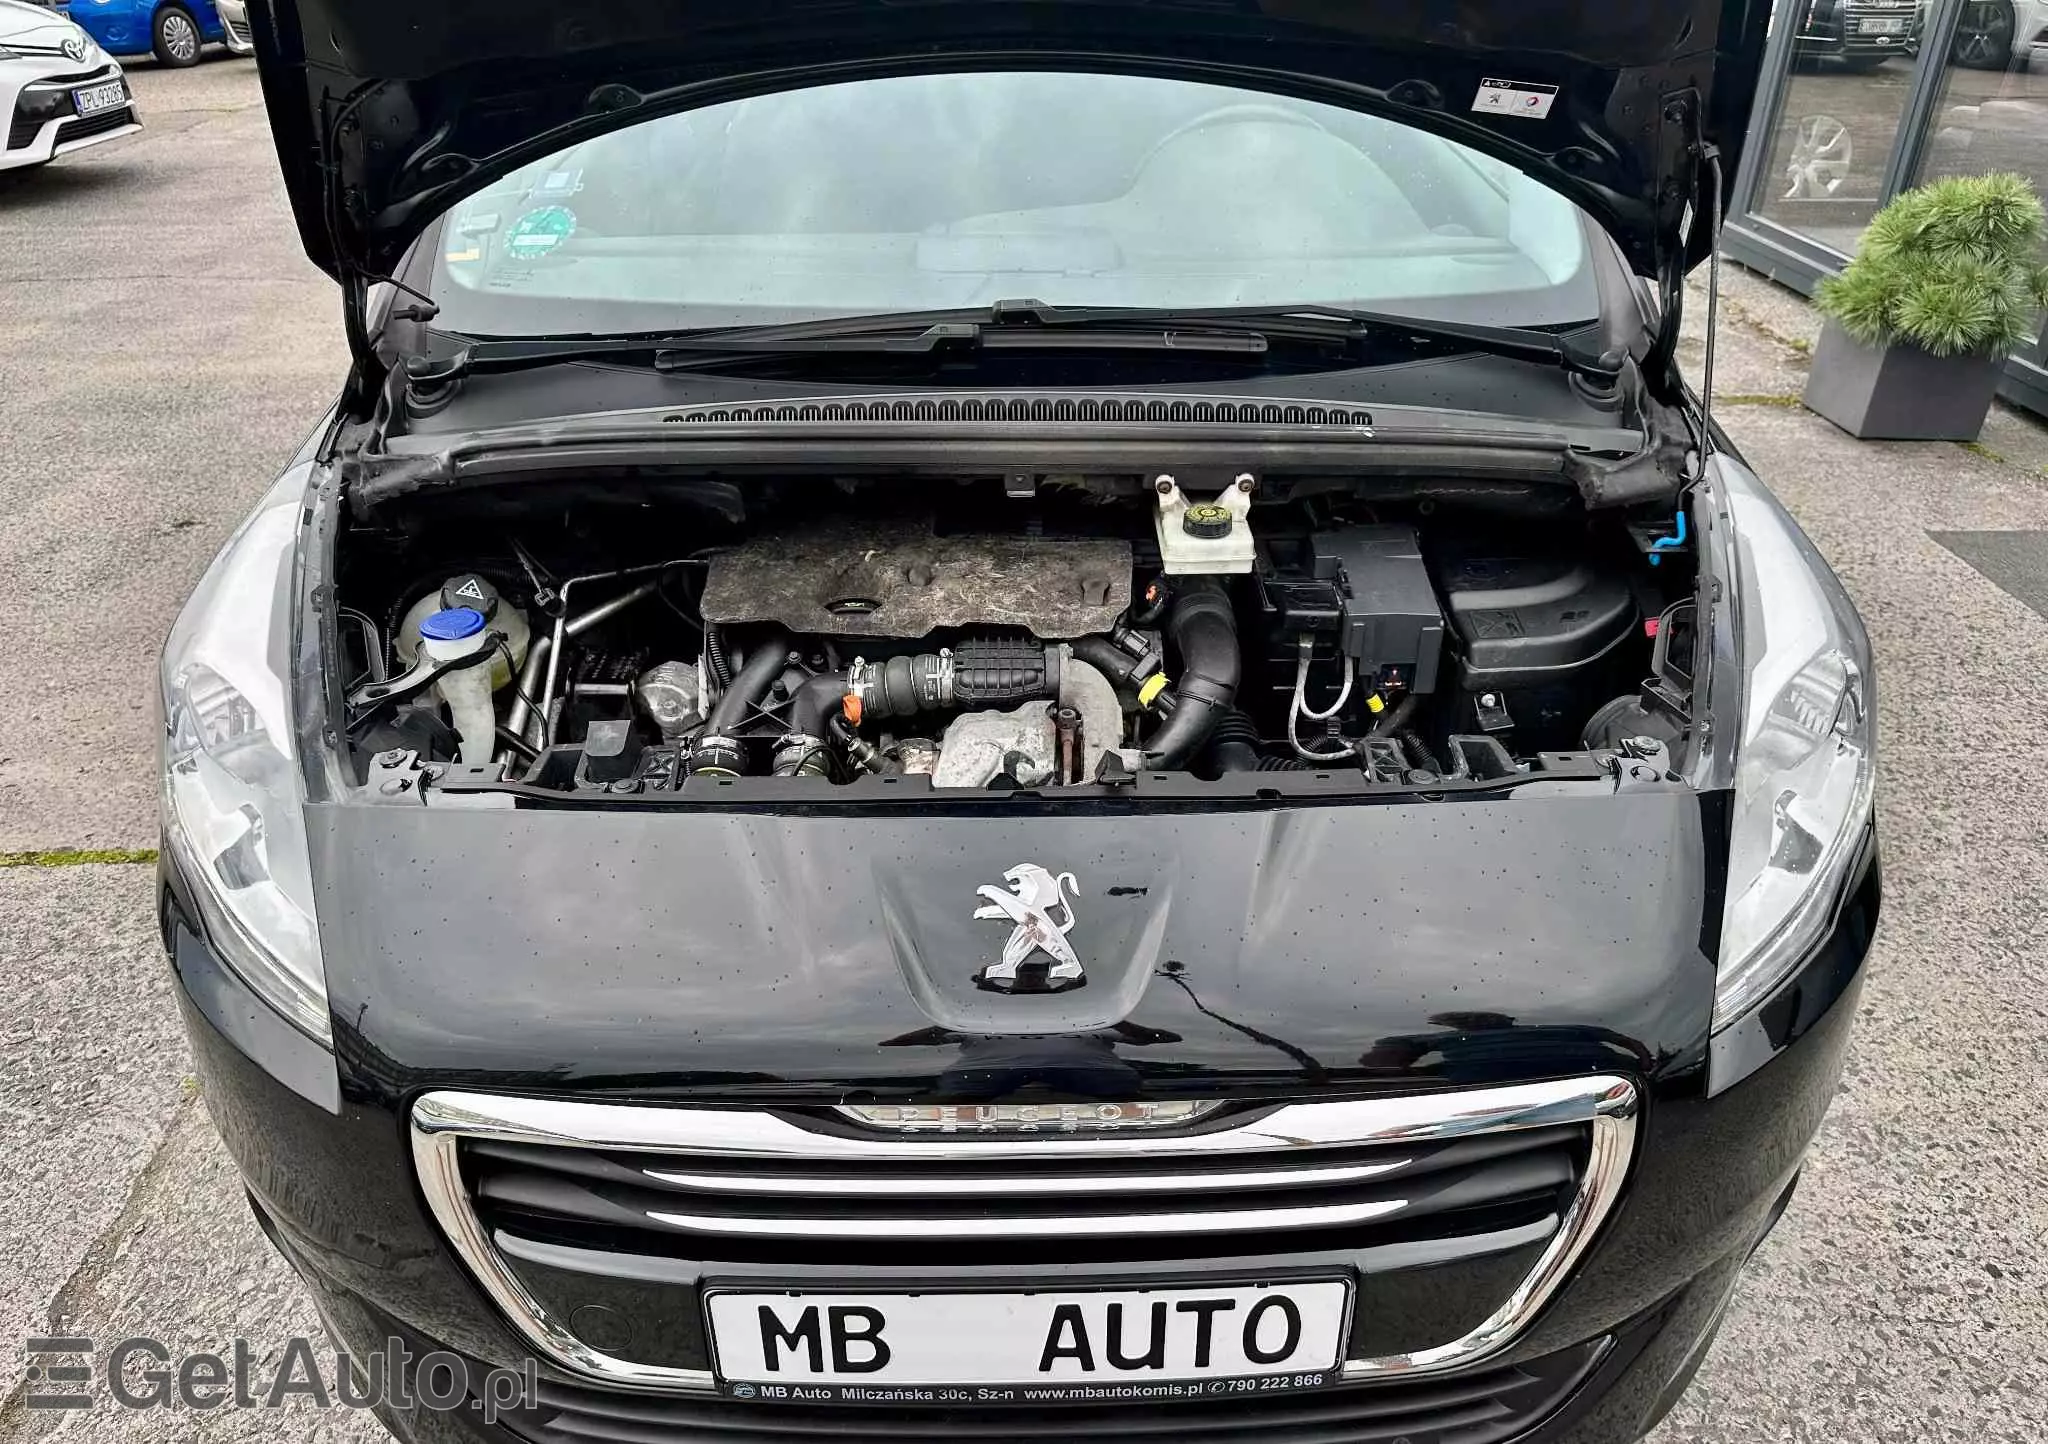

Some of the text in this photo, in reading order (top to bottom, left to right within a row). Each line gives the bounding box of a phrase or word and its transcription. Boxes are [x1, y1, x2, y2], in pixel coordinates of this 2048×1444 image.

[758, 1294, 1301, 1373] MB AUTO
[761, 1373, 1323, 1401] MB Auto Milczańska 30c, Sz-n www.mbautokomis.pl 790 222 866
